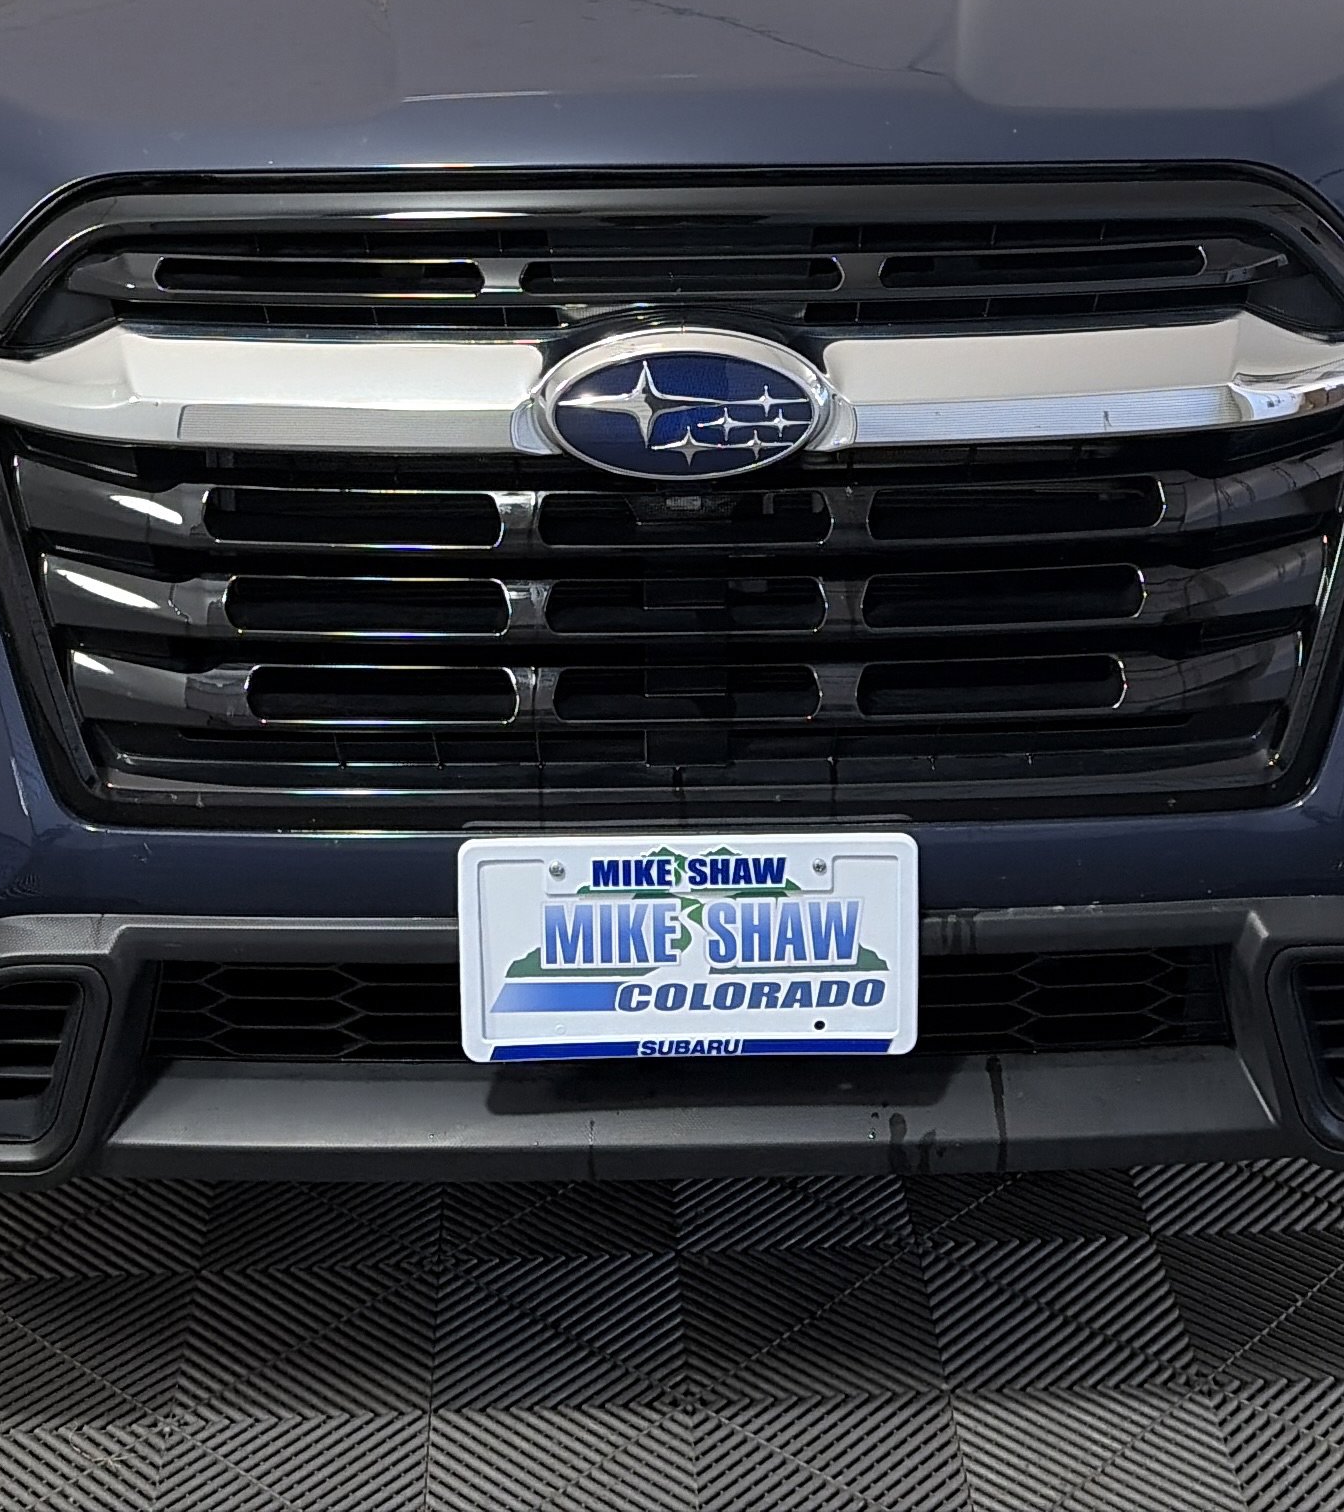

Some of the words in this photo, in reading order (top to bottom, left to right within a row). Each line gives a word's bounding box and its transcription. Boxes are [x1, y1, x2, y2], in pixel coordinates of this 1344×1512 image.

[592, 860, 672, 887] MIKE
[688, 857, 786, 886] SHAW
[544, 903, 679, 964] MIKE
[708, 901, 859, 963] SHAW
[618, 979, 885, 1011] COLORADO
[640, 1039, 740, 1056] SUBARU
